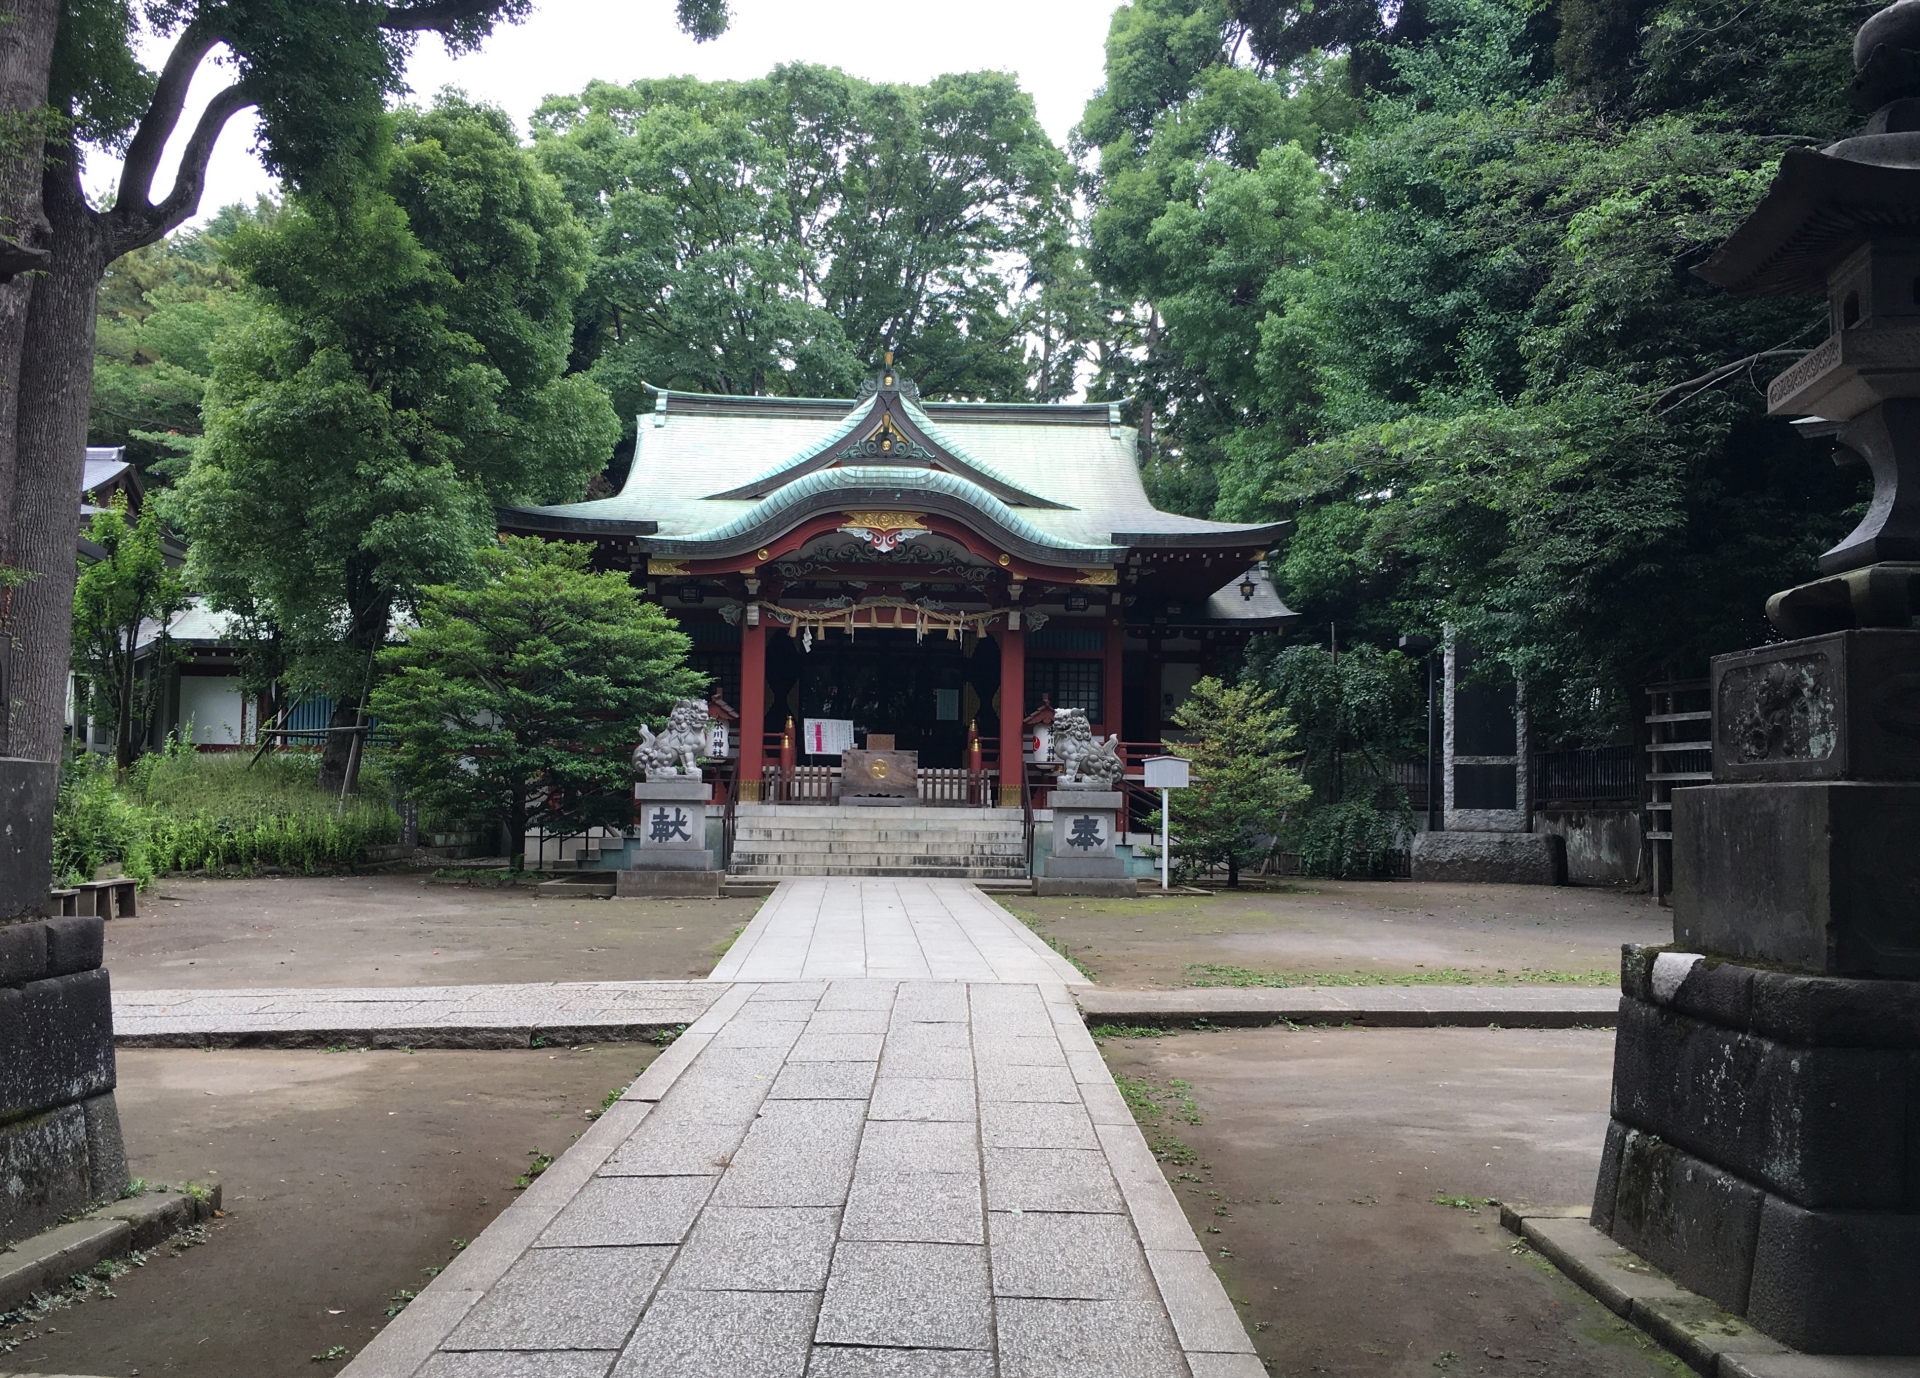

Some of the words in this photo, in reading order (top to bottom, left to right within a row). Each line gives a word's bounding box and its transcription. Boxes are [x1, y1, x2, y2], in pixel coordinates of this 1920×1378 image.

[712, 720, 724, 758] 氷川神社
[649, 807, 691, 843] 献
[1066, 815, 1105, 851] 奉
